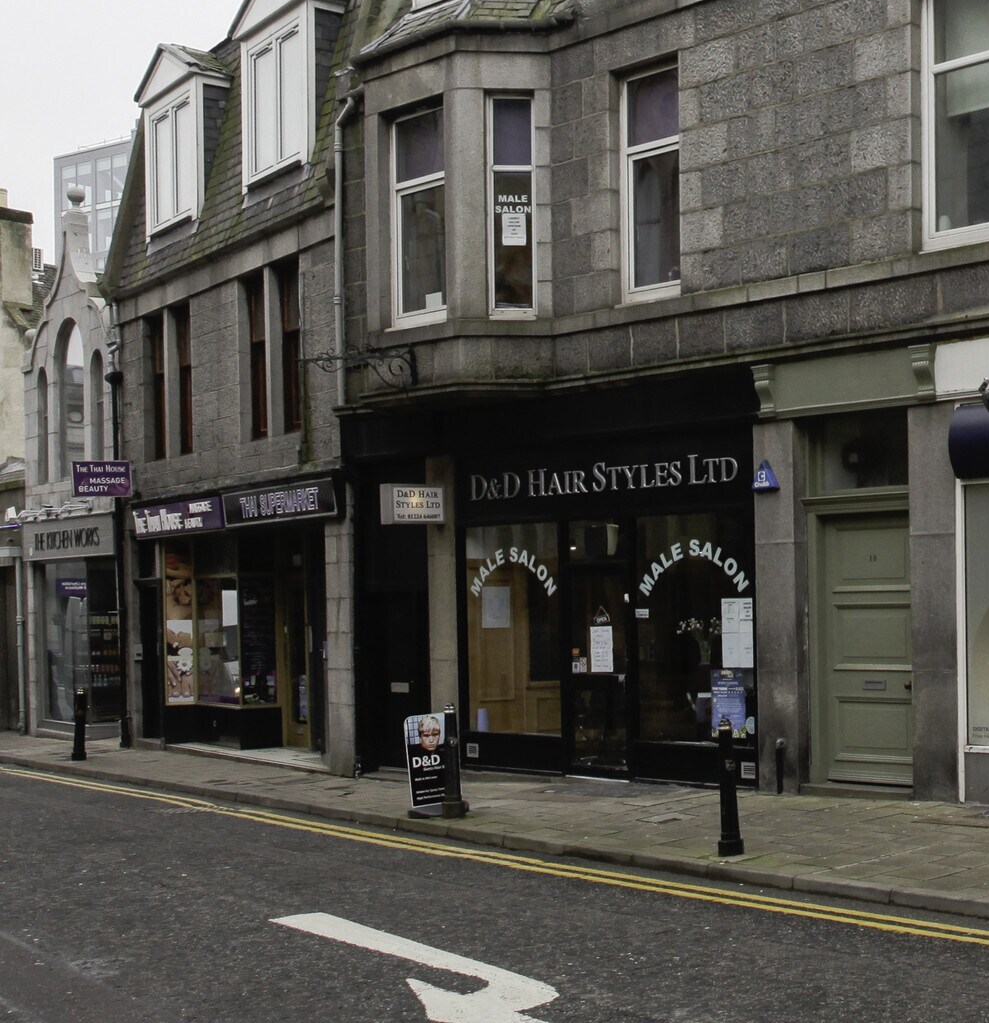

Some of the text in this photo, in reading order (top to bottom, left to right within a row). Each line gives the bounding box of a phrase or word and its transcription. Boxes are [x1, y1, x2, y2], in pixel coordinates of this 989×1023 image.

[76, 464, 126, 472] THE THAI HOUSE
[470, 454, 738, 501] D&D HAIR STYLES LTD
[240, 486, 318, 518] THAI SUPERMARKET
[396, 500, 424, 508] STYLES
[419, 490, 439, 498] HAIR
[47, 530, 72, 550] KITCHEN
[74, 527, 100, 547] WORKS
[470, 546, 557, 597] MALE SALON
[639, 539, 749, 596] MALE SALON
[412, 754, 440, 768] D&D
